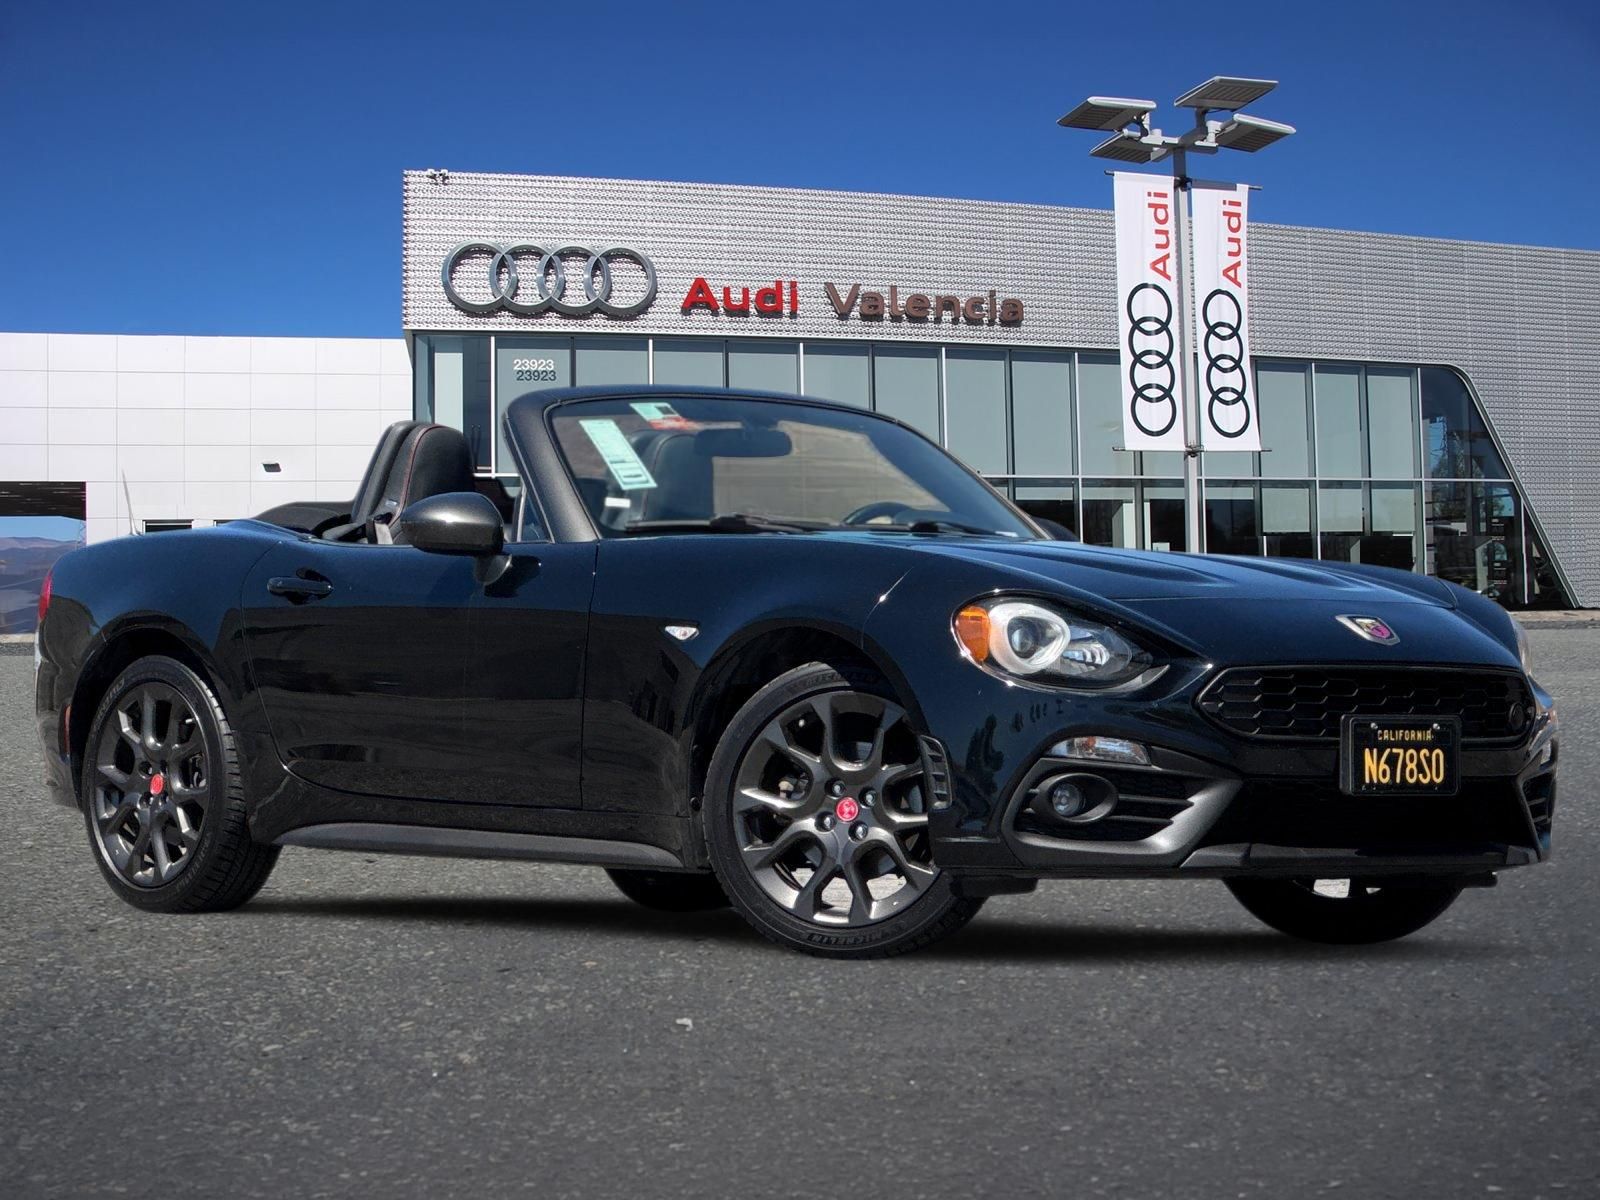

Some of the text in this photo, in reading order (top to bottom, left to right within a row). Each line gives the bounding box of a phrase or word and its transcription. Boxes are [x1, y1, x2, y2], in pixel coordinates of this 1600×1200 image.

[1147, 191, 1172, 282] Audi
[1222, 199, 1242, 288] Audi
[681, 277, 1024, 322] Audi Valencia
[513, 359, 554, 370] 23923
[516, 370, 557, 381] 23923
[1377, 729, 1432, 741] CALIFORNIA
